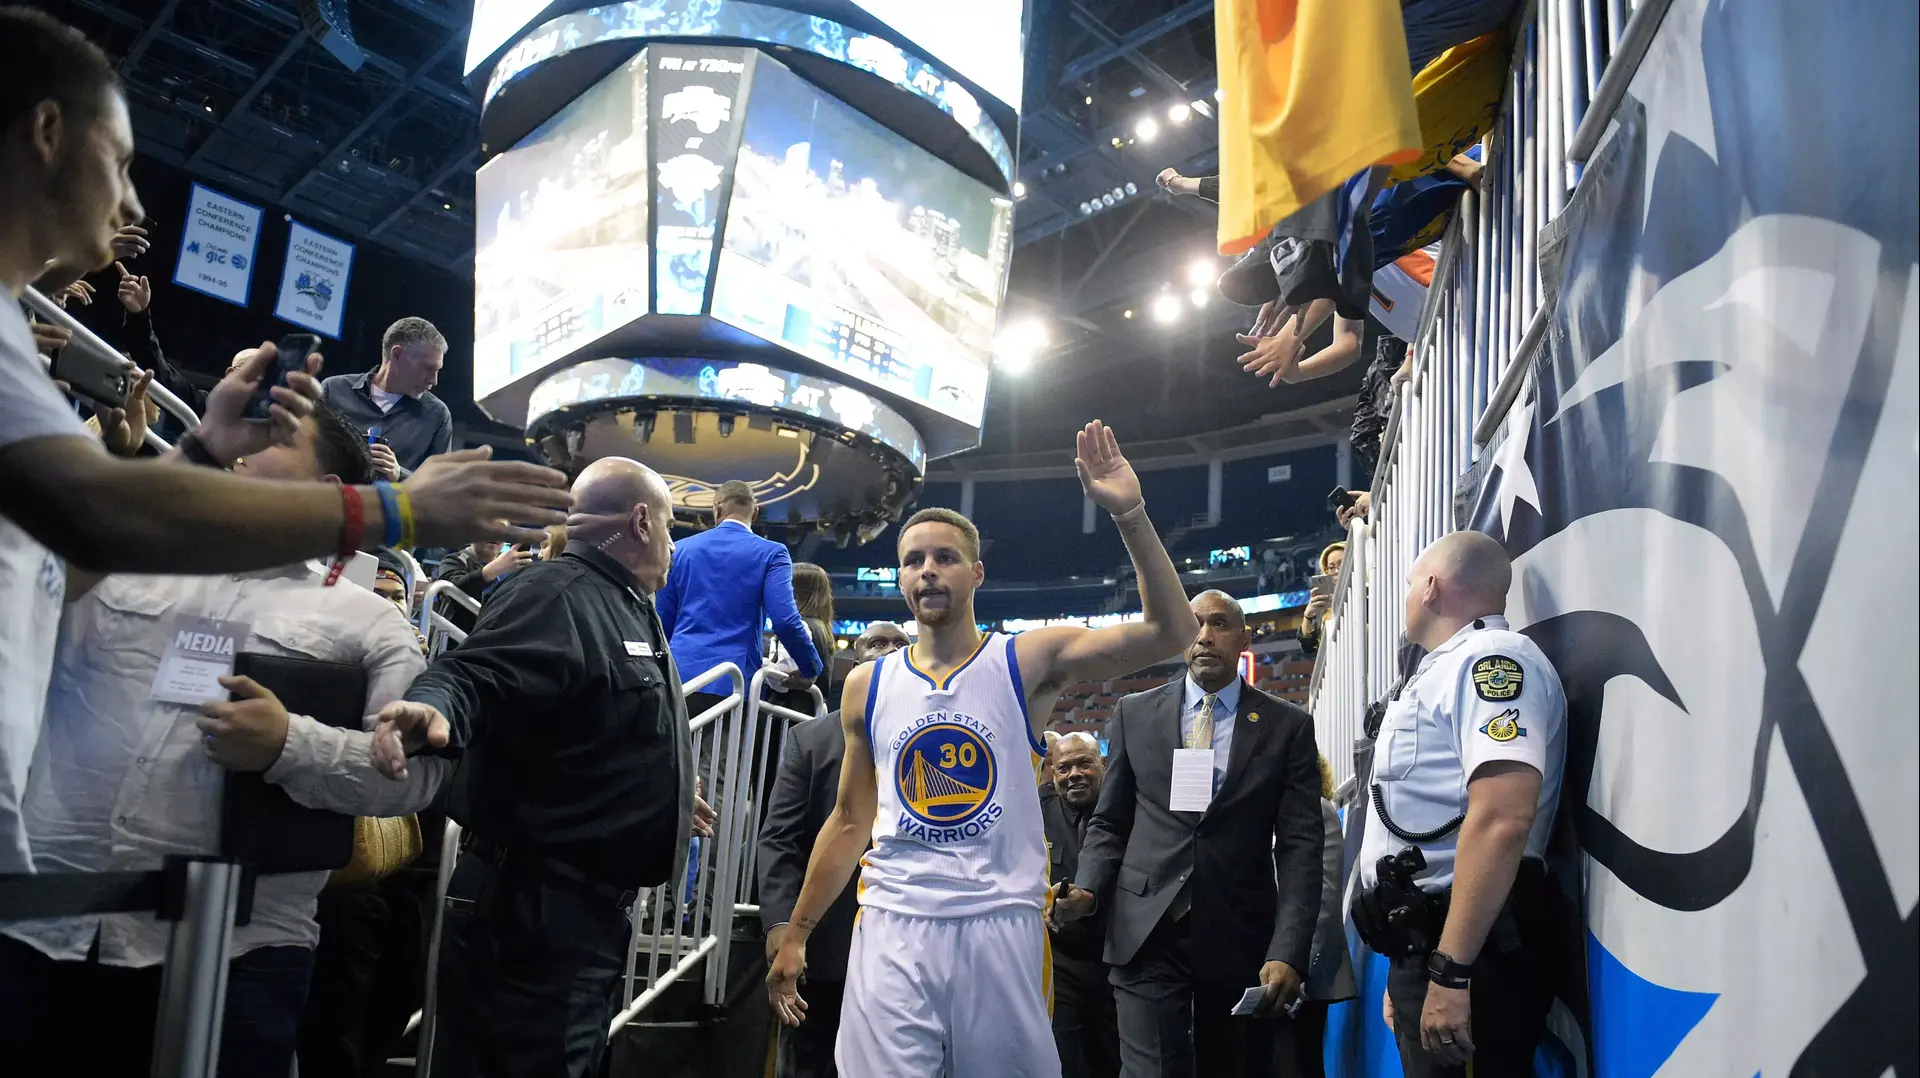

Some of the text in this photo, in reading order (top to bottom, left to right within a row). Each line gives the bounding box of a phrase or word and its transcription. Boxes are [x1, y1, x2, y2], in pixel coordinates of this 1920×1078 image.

[911, 69, 940, 96] AT
[196, 208, 252, 233] CONFERENCE
[207, 201, 244, 220] EASTERN
[198, 219, 246, 241] CHAMPIONS
[294, 244, 344, 268] CONFERENCE
[304, 238, 338, 256] EASTERN
[295, 255, 339, 276] CHAMPIONS
[198, 273, 228, 288] 1994-95
[791, 385, 824, 409] AT
[175, 630, 234, 656] MEDIA
[1478, 660, 1517, 671] ORLANDO
[893, 712, 996, 751] GOLDEN STATE
[940, 742, 977, 769] 30
[898, 802, 1003, 843] WARRIORS
